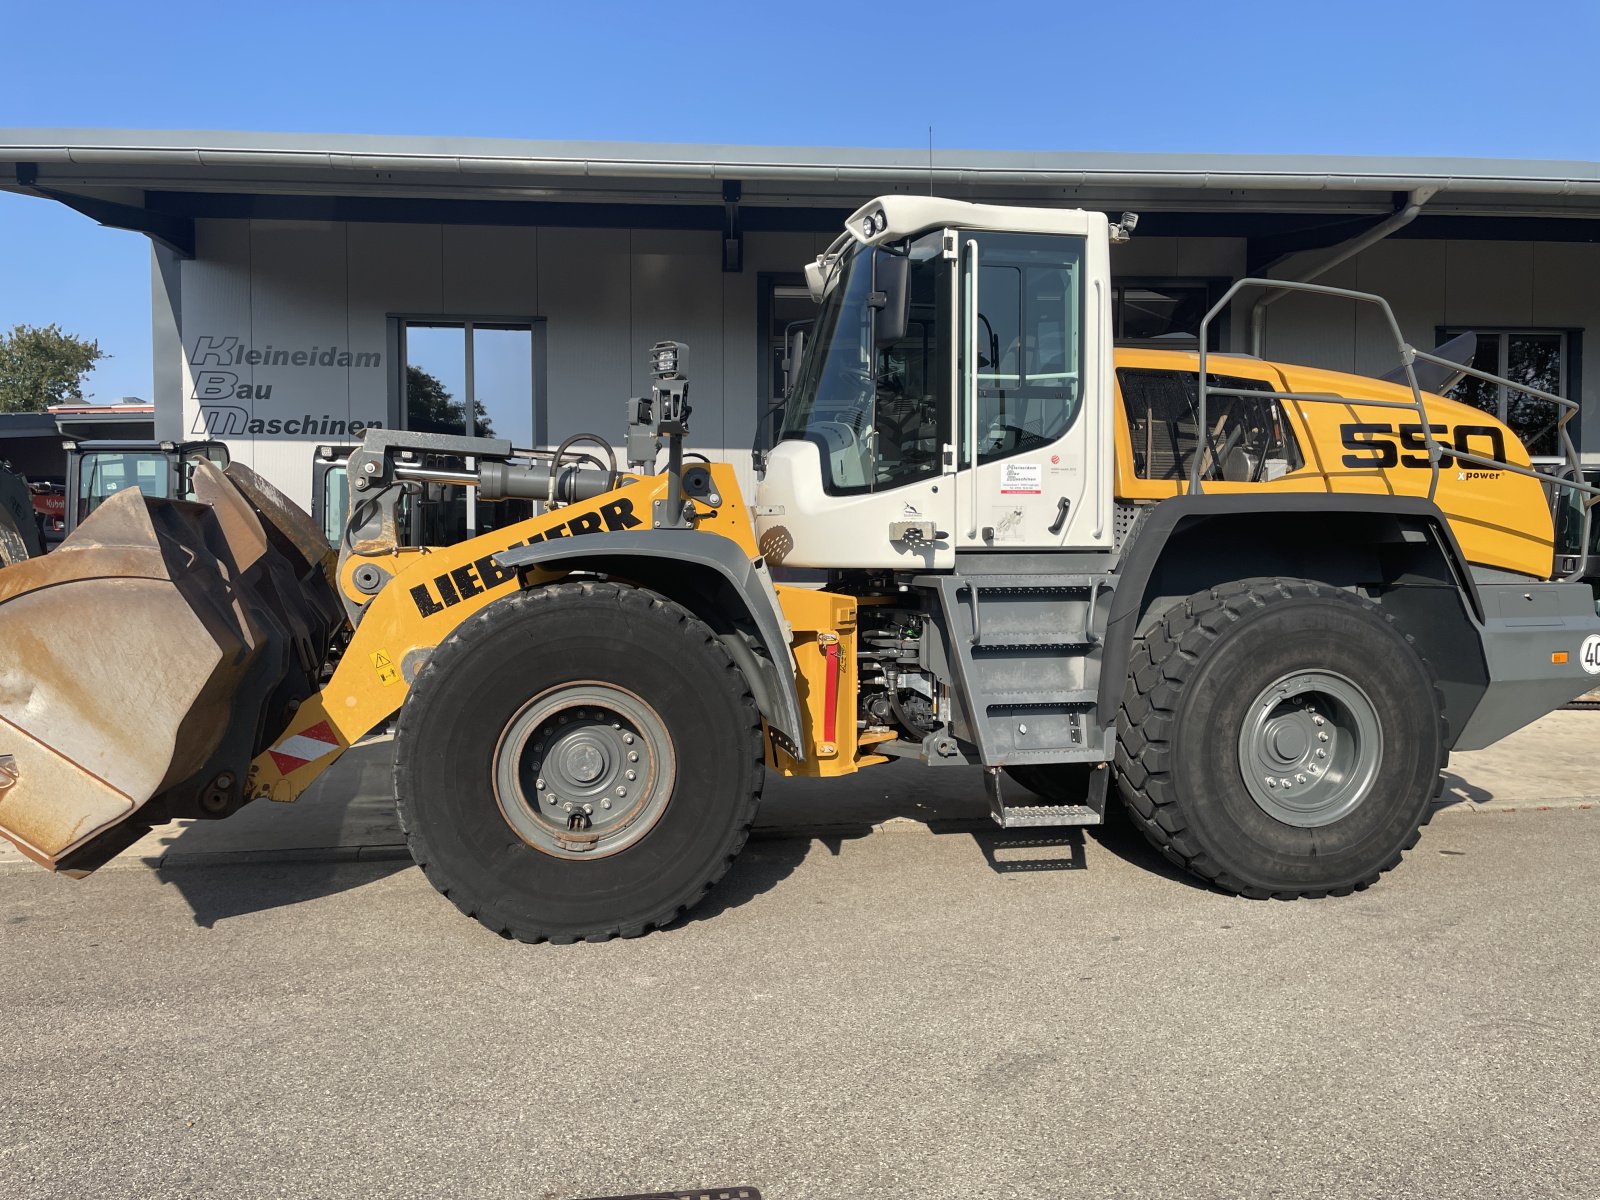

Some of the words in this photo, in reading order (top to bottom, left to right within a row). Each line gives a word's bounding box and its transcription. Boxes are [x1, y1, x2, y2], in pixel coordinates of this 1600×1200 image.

[190, 336, 382, 368] Kleineidam
[190, 370, 273, 400] Bau
[190, 405, 383, 435] Maschinen
[1339, 423, 1507, 471] 550
[46, 499, 65, 509] Kubot
[1584, 642, 1600, 667] 40
